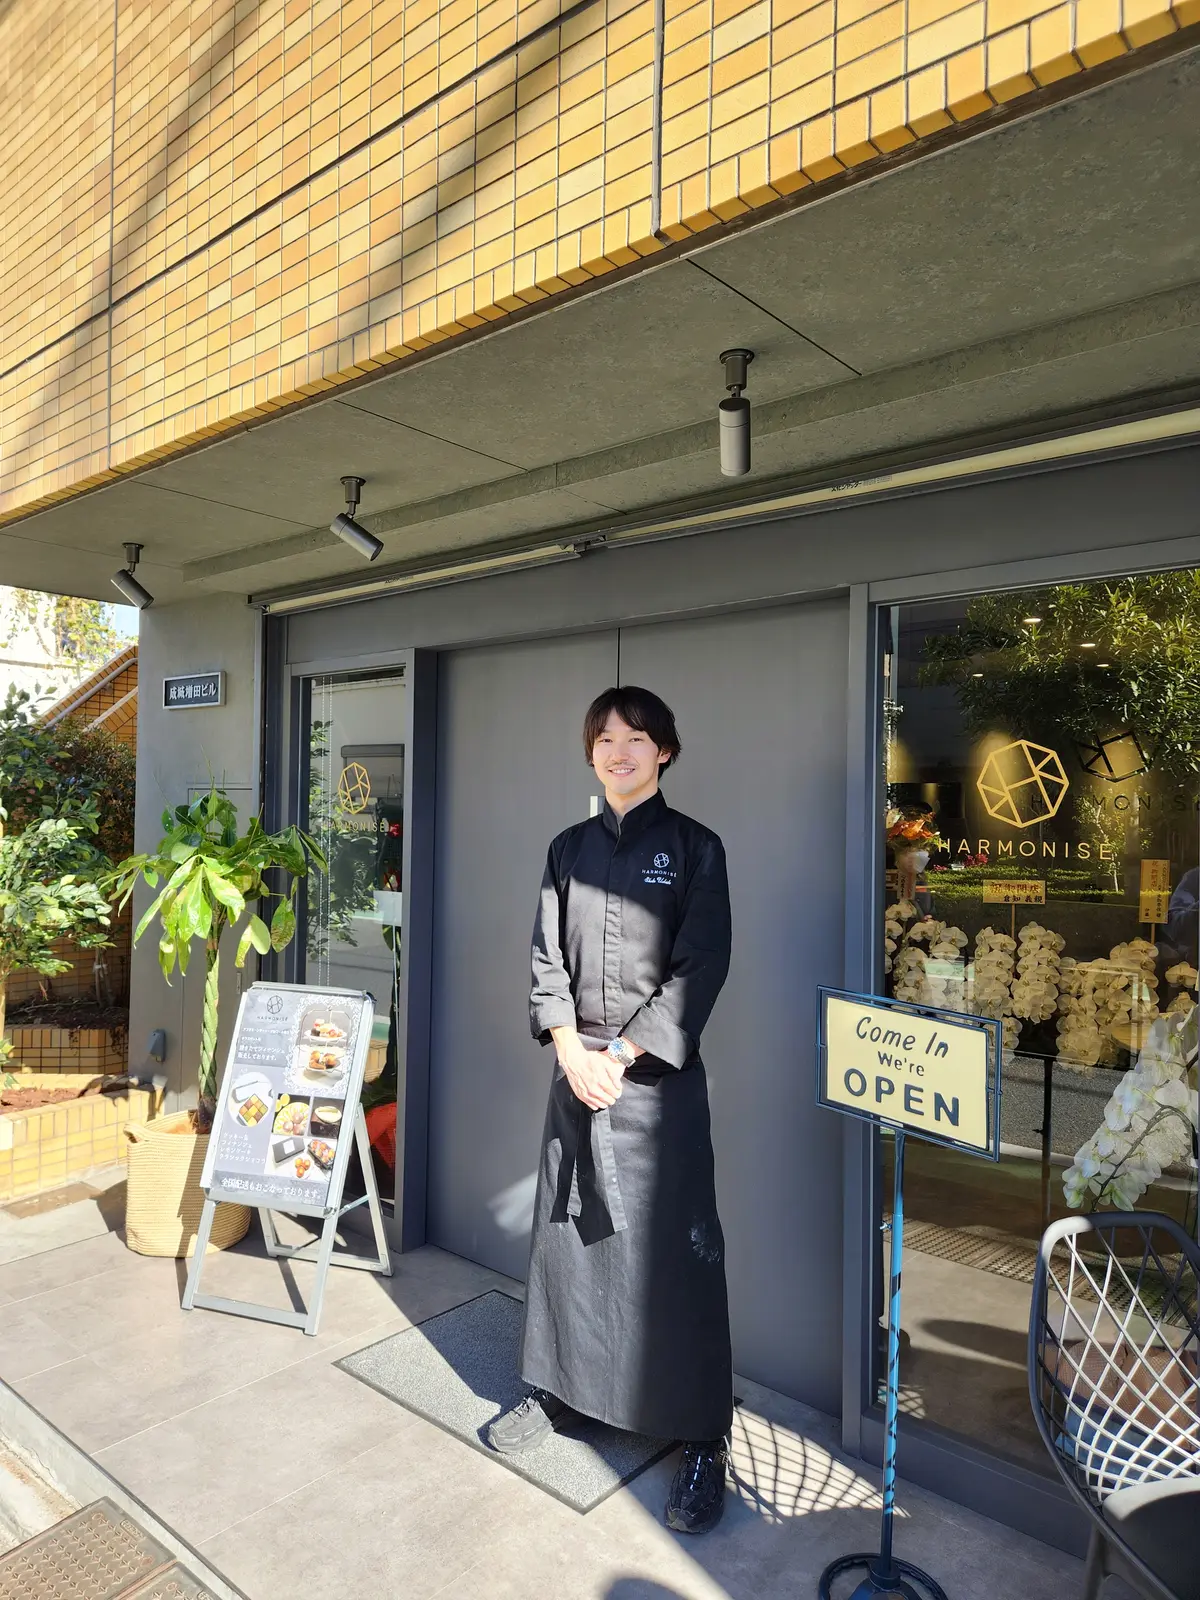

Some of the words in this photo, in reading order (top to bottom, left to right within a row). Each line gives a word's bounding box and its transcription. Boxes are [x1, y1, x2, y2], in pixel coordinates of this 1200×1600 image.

[169, 682, 217, 700] 成城増田ビル
[856, 1016, 916, 1051] Come
[925, 1032, 949, 1058] In
[844, 1068, 960, 1127] OPEN
